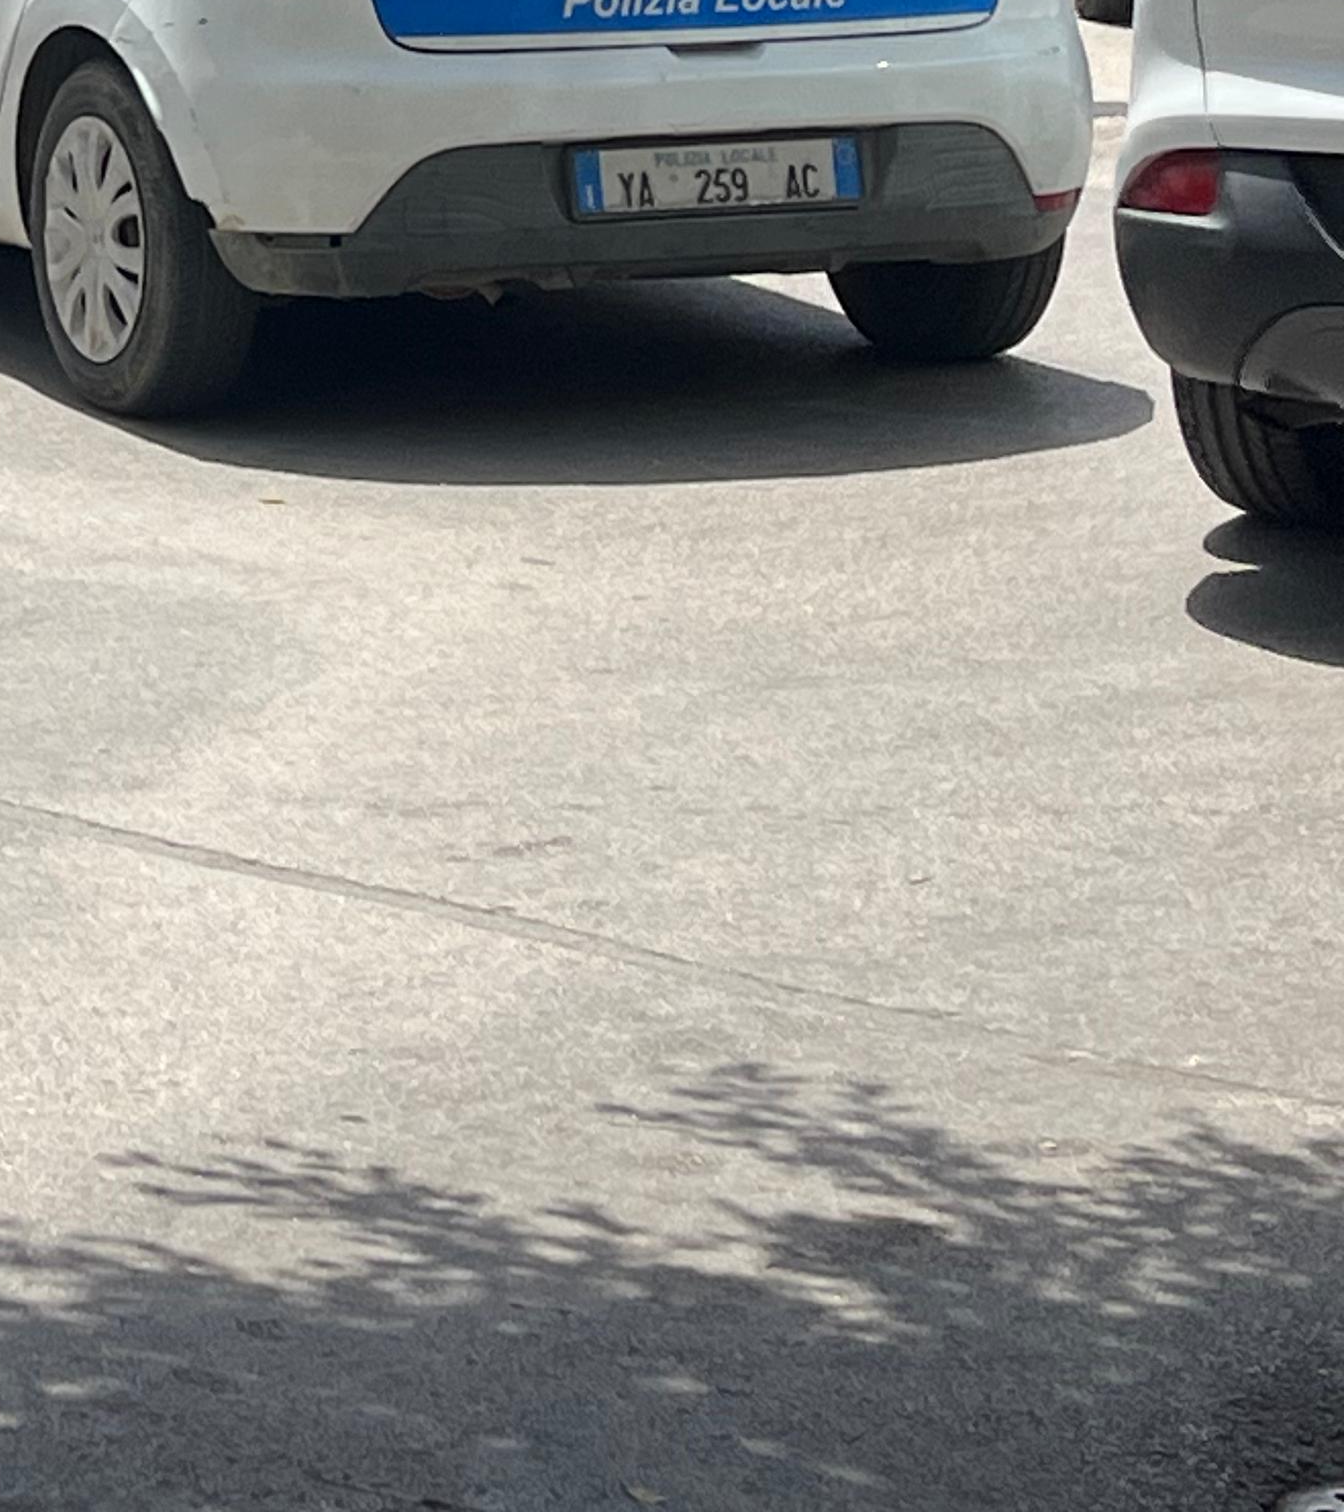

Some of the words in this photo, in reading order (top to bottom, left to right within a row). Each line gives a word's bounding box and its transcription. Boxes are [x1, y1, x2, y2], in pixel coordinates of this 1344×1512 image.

[654, 151, 712, 168] POLIZIA
[720, 147, 779, 165] LOCALE
[617, 172, 655, 208] YA
[694, 168, 749, 204] 259
[786, 163, 821, 199] AC
